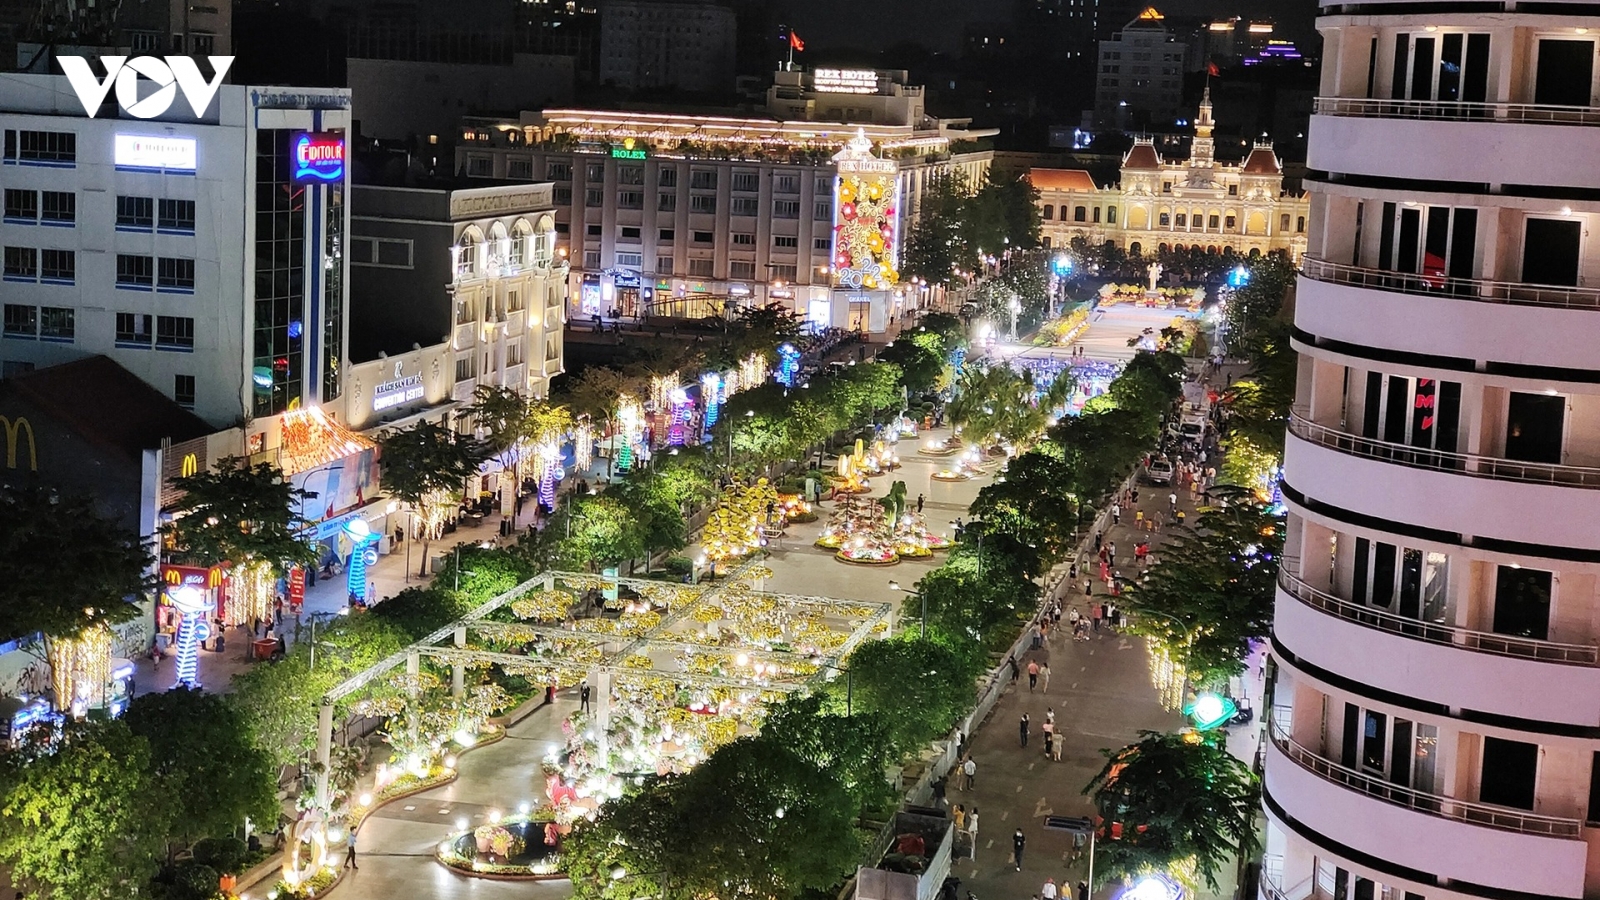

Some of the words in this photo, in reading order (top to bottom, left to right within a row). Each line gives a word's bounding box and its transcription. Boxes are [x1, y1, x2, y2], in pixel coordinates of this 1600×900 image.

[815, 69, 840, 79] REX
[841, 70, 878, 81] HOTEL
[299, 142, 343, 162] FIDITOUR
[612, 149, 647, 160] ROLEX
[840, 161, 858, 171] REX
[860, 161, 897, 173] HOTEL
[840, 257, 881, 289] 2022
[406, 386, 424, 402] CENTER
